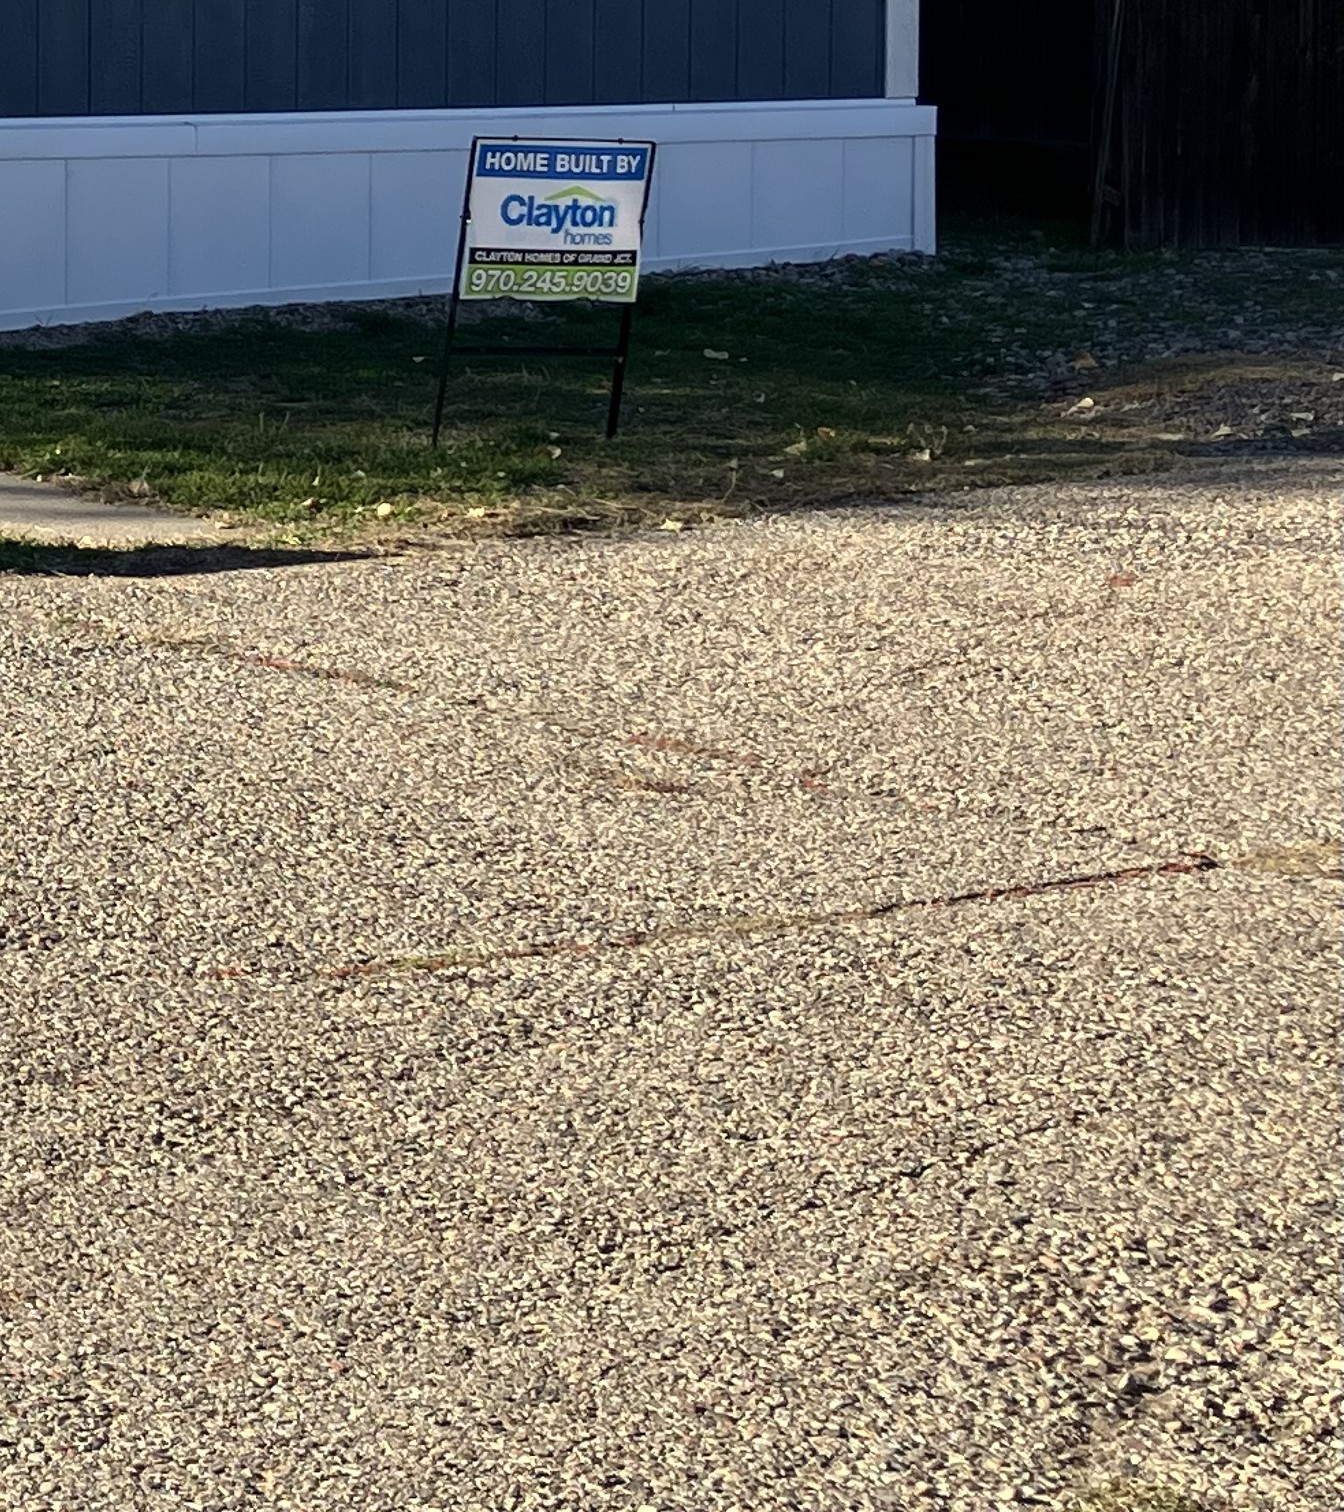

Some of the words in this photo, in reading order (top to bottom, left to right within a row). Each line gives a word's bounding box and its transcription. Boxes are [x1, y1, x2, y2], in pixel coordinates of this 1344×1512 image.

[485, 152, 550, 172] HOME
[556, 154, 612, 173] BUILT
[616, 155, 640, 173] BY
[500, 194, 615, 234] Clayton
[563, 229, 612, 246] homes
[475, 251, 523, 262] CLAYTON
[563, 253, 577, 263] OF
[471, 270, 631, 293] 970.245.9039
